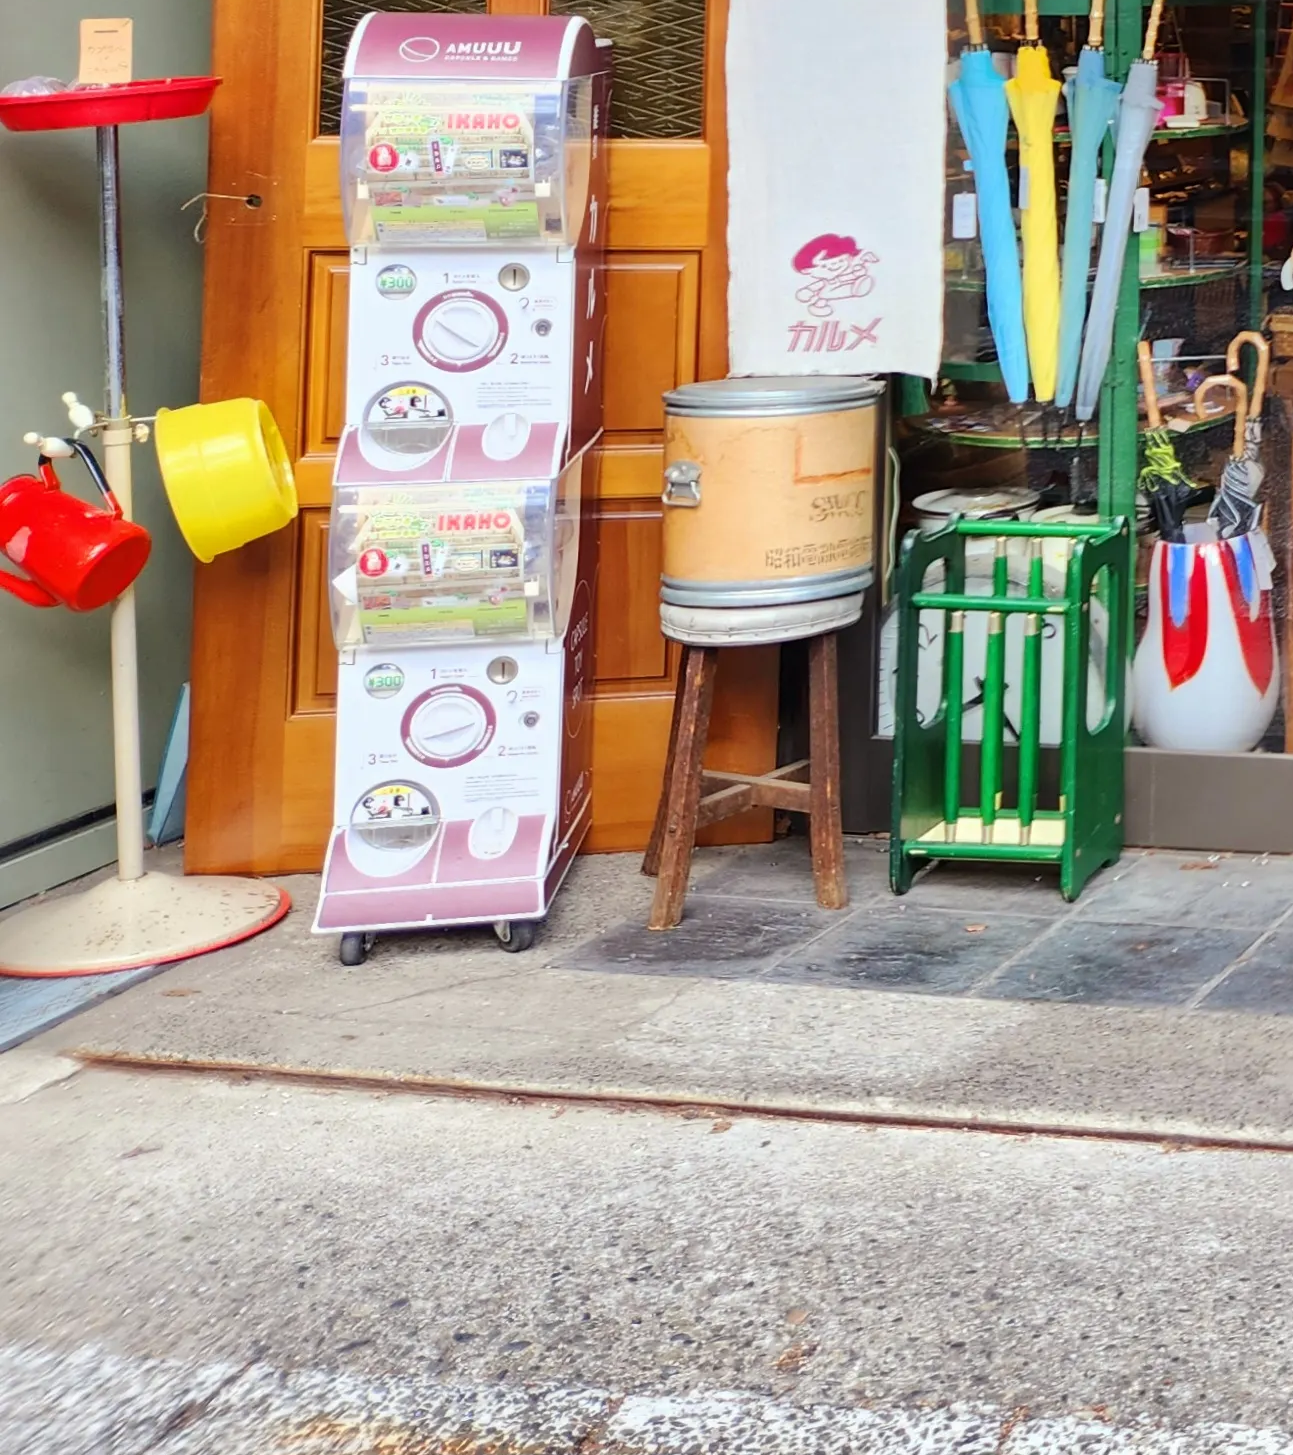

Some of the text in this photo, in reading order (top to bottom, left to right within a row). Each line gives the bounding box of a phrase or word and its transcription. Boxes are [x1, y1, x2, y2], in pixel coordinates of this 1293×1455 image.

[446, 41, 522, 55] AMUUU
[447, 113, 521, 130] IKAHO
[380, 276, 413, 289] ¥300
[787, 317, 883, 352] カルメ
[380, 354, 389, 366] 3
[510, 353, 518, 364] 2
[437, 512, 511, 532] IKAHO
[368, 675, 403, 688] ¥300
[498, 745, 506, 757] 2
[368, 754, 377, 765] 3
